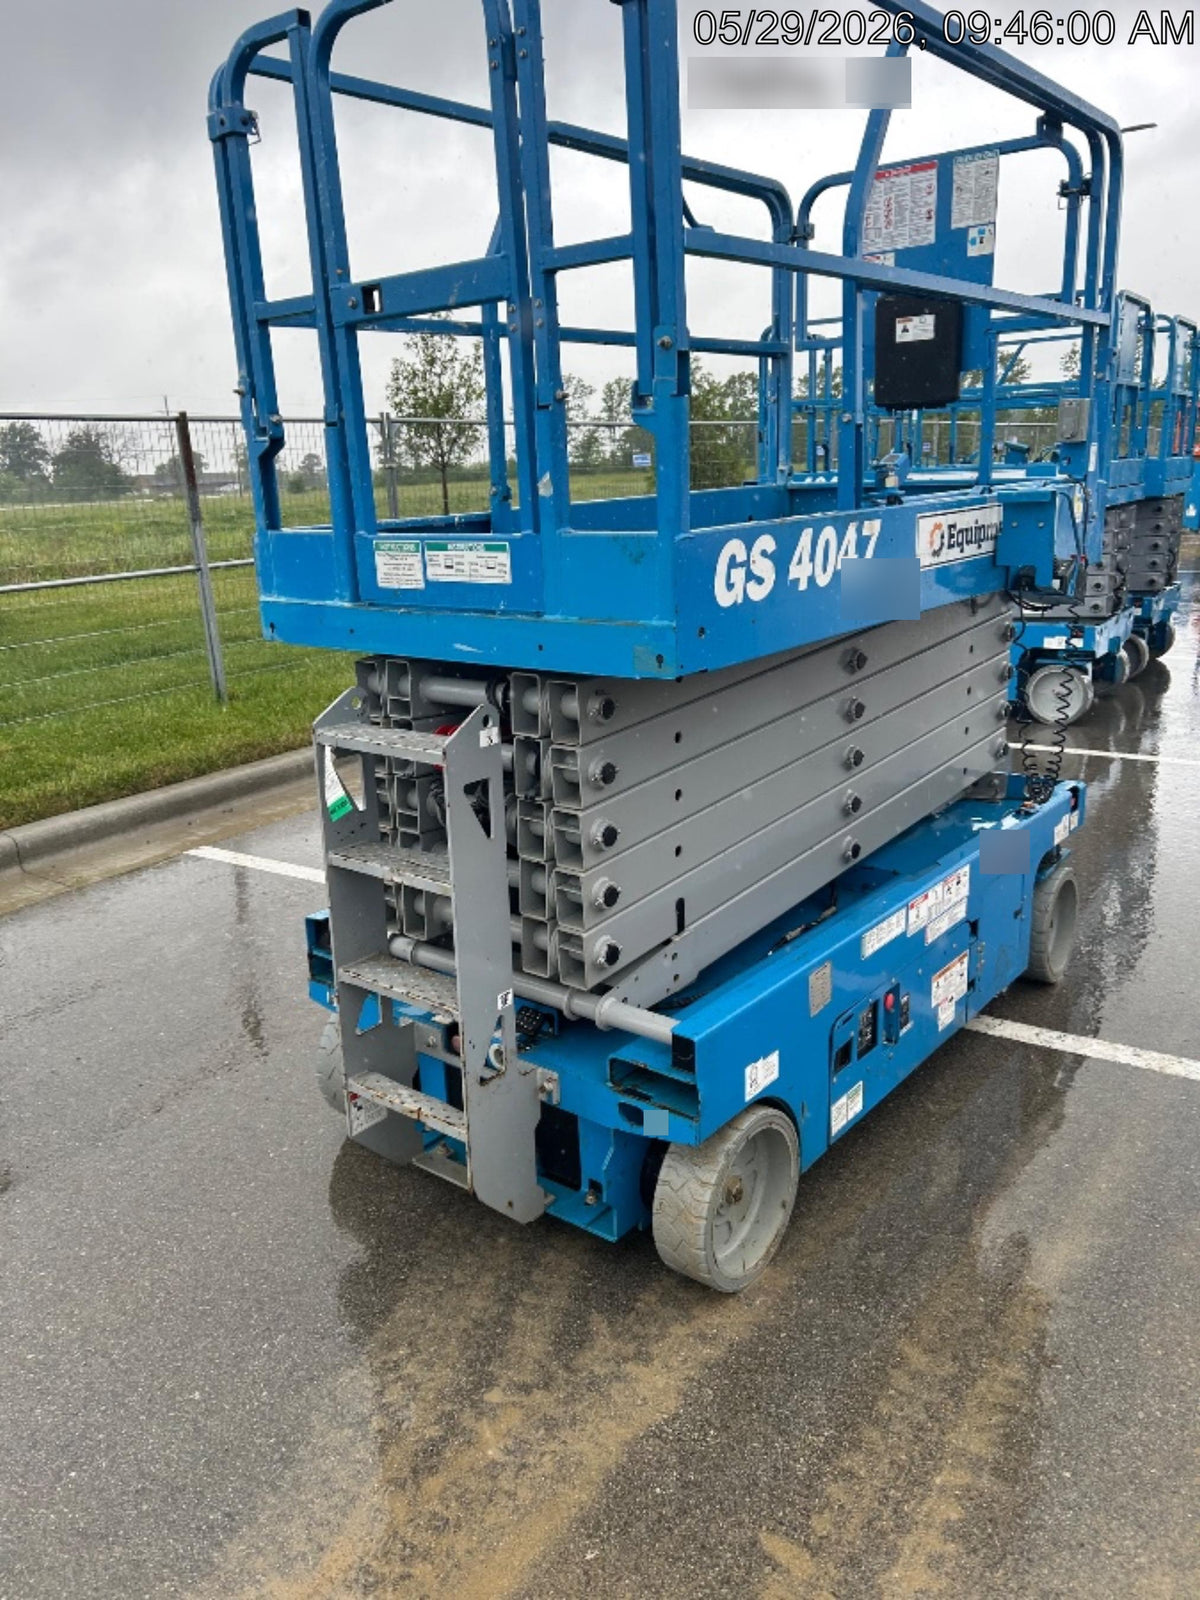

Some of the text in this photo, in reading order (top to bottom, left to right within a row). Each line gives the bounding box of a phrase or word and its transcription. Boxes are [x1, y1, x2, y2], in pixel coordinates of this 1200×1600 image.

[714, 518, 882, 608] GS 4047
[947, 518, 1002, 554] Equipm
